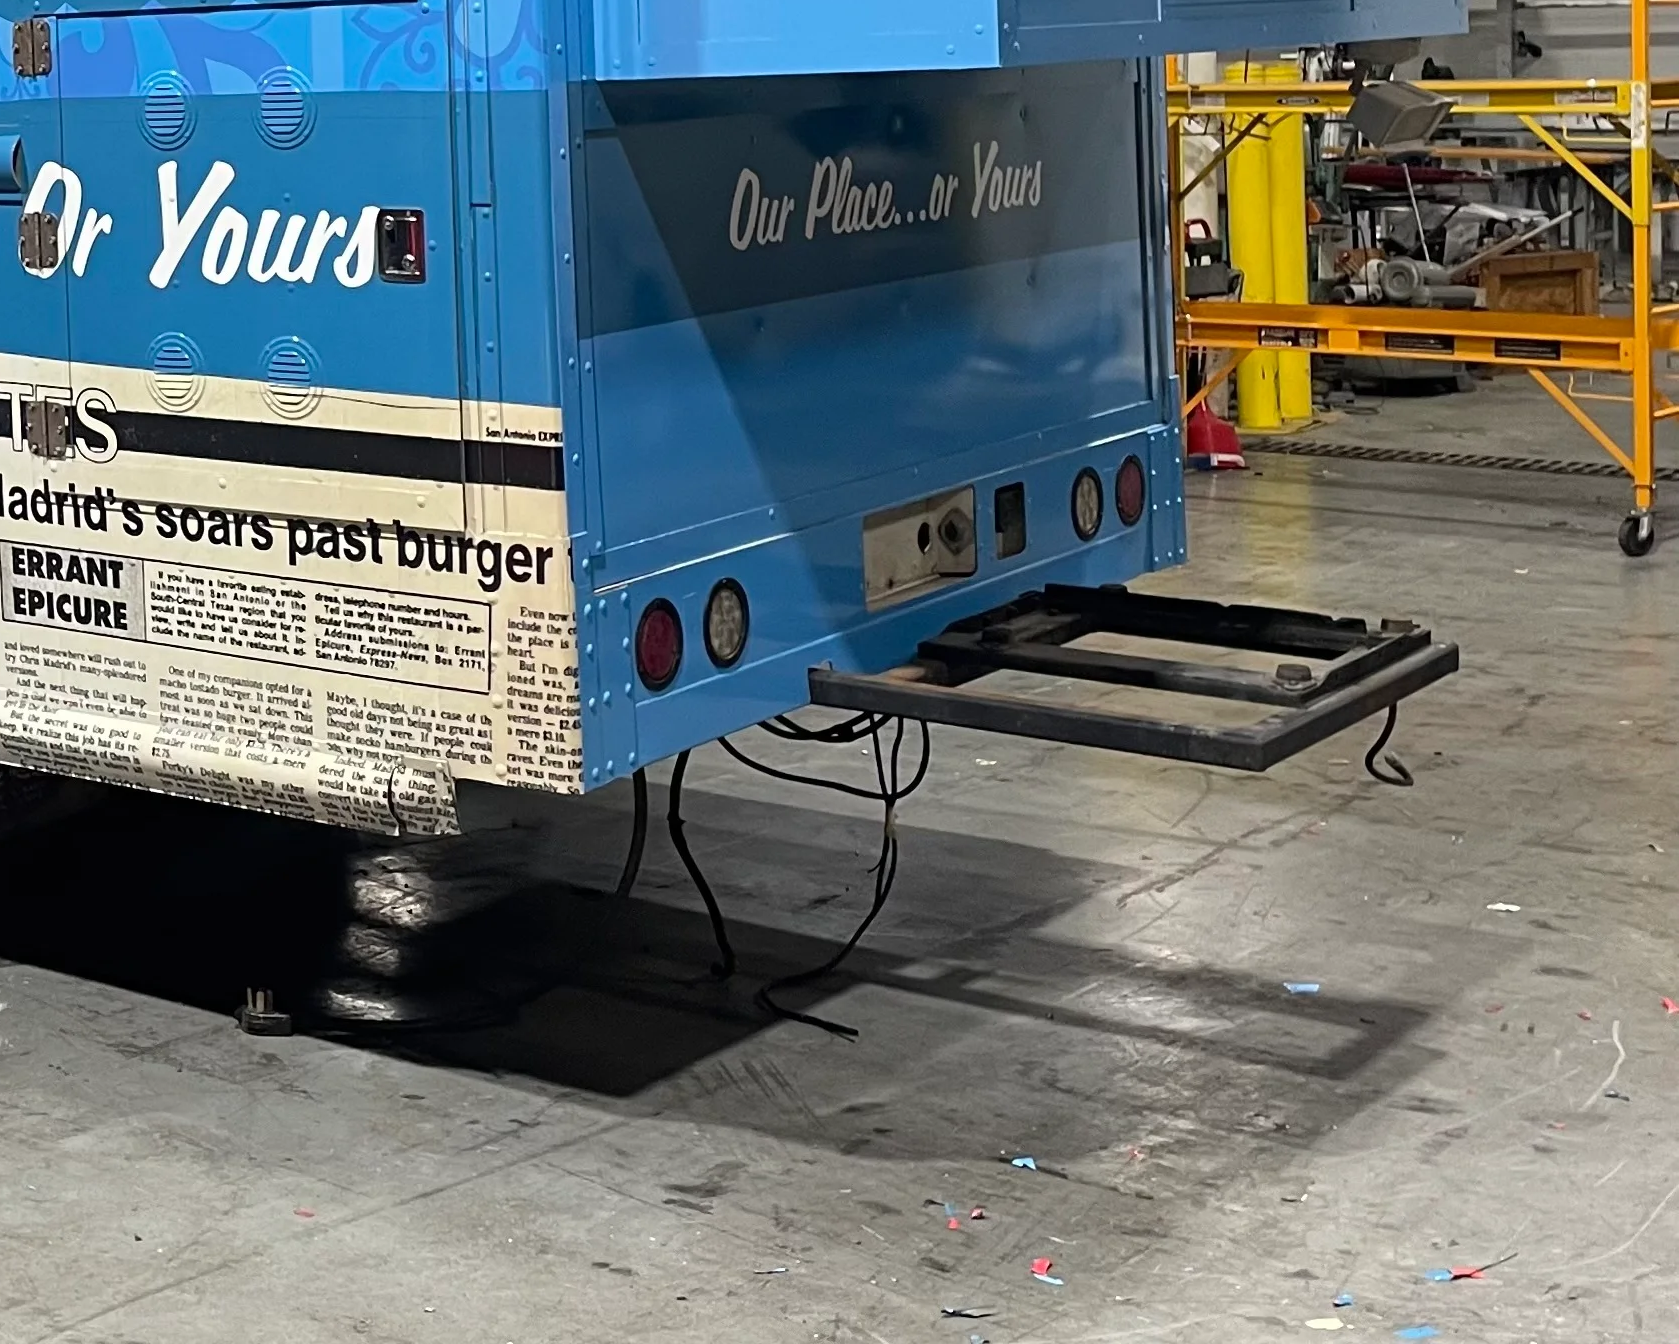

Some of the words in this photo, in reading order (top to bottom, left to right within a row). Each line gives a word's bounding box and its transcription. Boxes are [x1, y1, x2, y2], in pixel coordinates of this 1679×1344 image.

[729, 168, 794, 251] Our
[971, 140, 1042, 219] Yours
[18, 160, 111, 282] Or
[148, 160, 382, 289] Yours
[486, 426, 501, 438] San
[504, 428, 536, 442] Antonio
[156, 503, 274, 552] soars
[288, 517, 384, 574] past
[395, 519, 554, 593] burger
[11, 546, 124, 589] ERRANT
[12, 586, 128, 631] EPICURE
[519, 606, 545, 621] Even
[548, 612, 569, 623] now
[507, 618, 542, 634] include
[546, 623, 562, 635] the
[324, 628, 362, 642] Address
[368, 635, 429, 652] submissions
[507, 632, 523, 645] the
[528, 634, 554, 651] place
[560, 638, 569, 649] is
[315, 649, 332, 661] San
[334, 652, 368, 666] Antonio
[435, 654, 453, 667] Box
[168, 665, 184, 676] One
[519, 660, 536, 673] But
[506, 686, 543, 701] dreams
[546, 692, 563, 702] are
